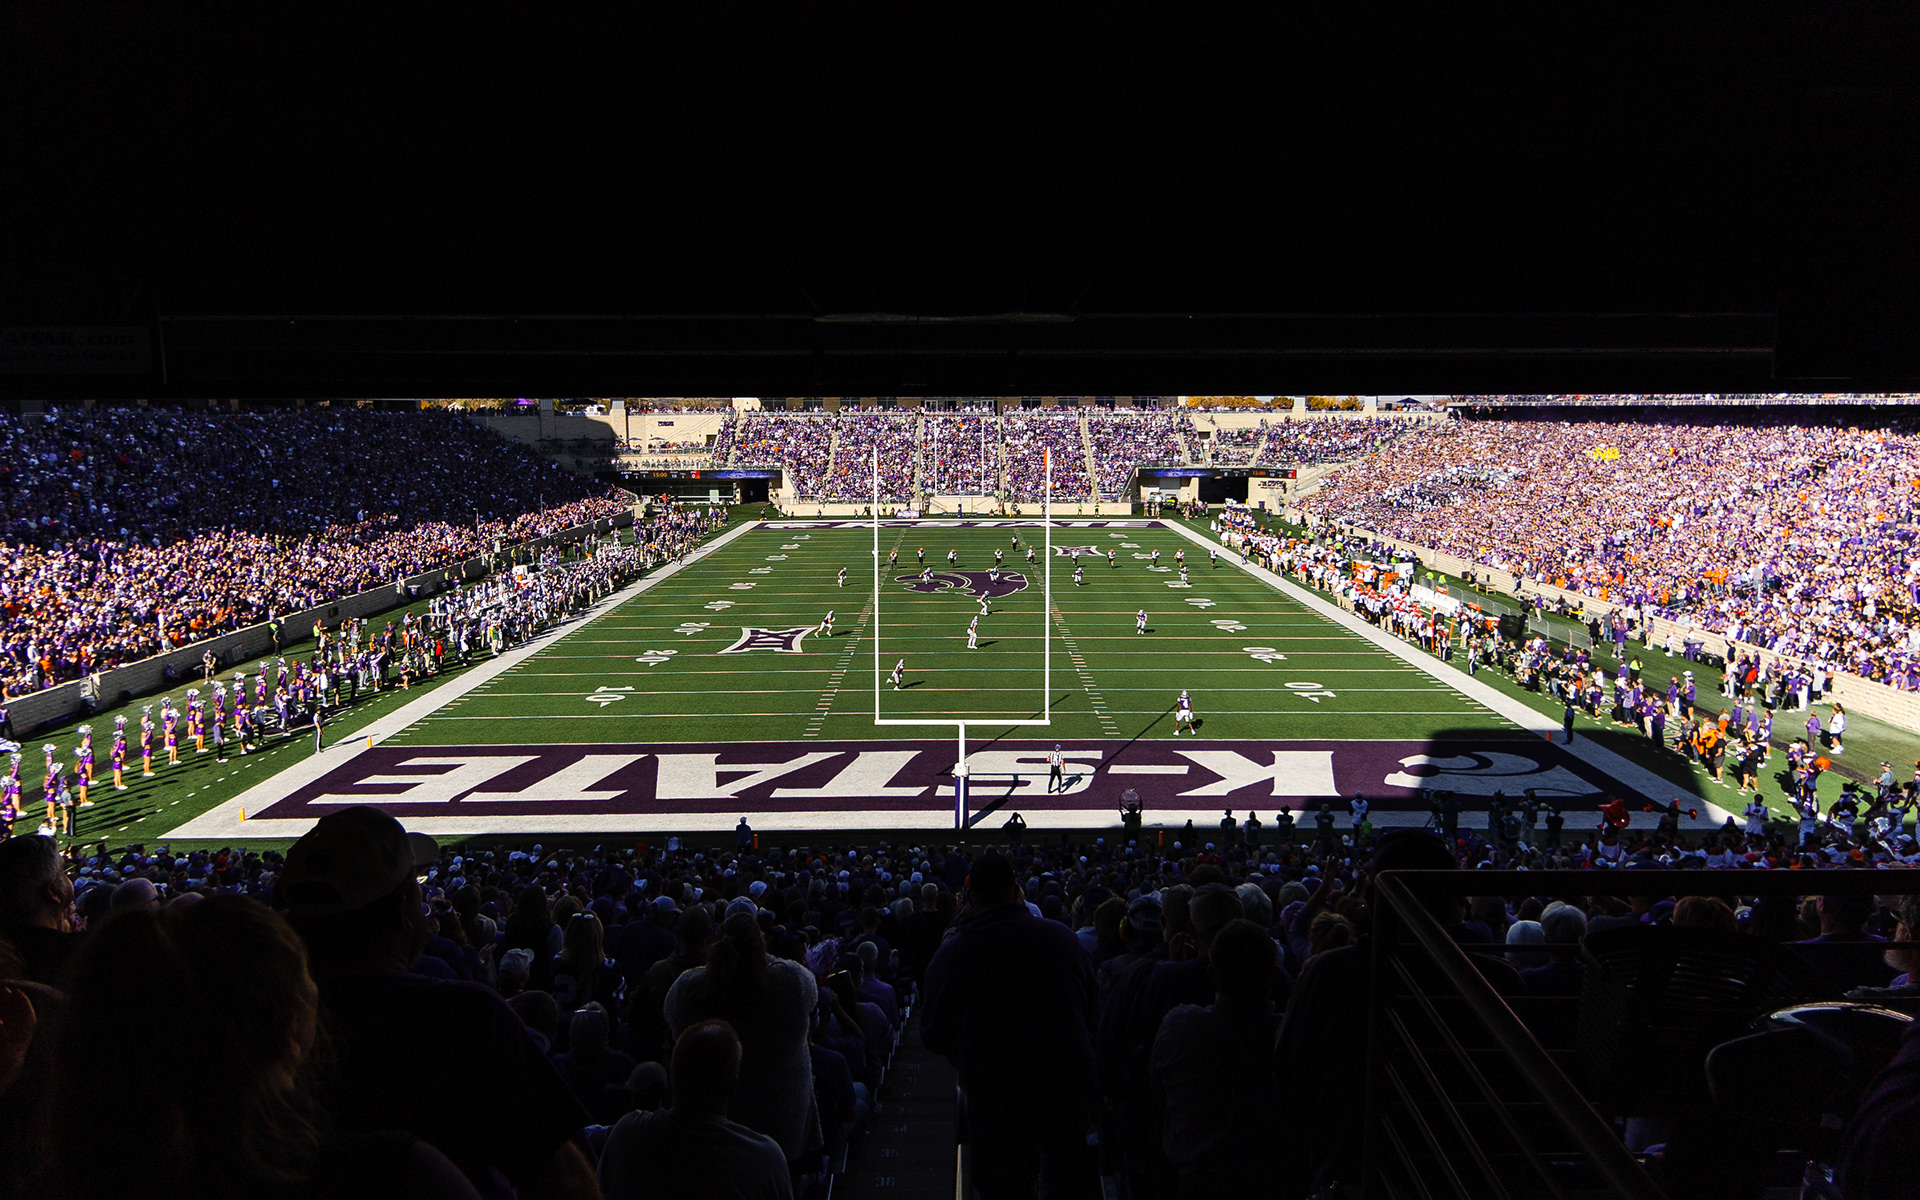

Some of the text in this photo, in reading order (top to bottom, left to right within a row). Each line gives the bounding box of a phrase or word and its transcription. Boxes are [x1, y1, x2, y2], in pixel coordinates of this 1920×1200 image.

[0, 331, 134, 346] ATSNIL.com
[585, 686, 635, 702] 10
[1284, 682, 1336, 699] 10
[308, 749, 1341, 806] K-STATE
